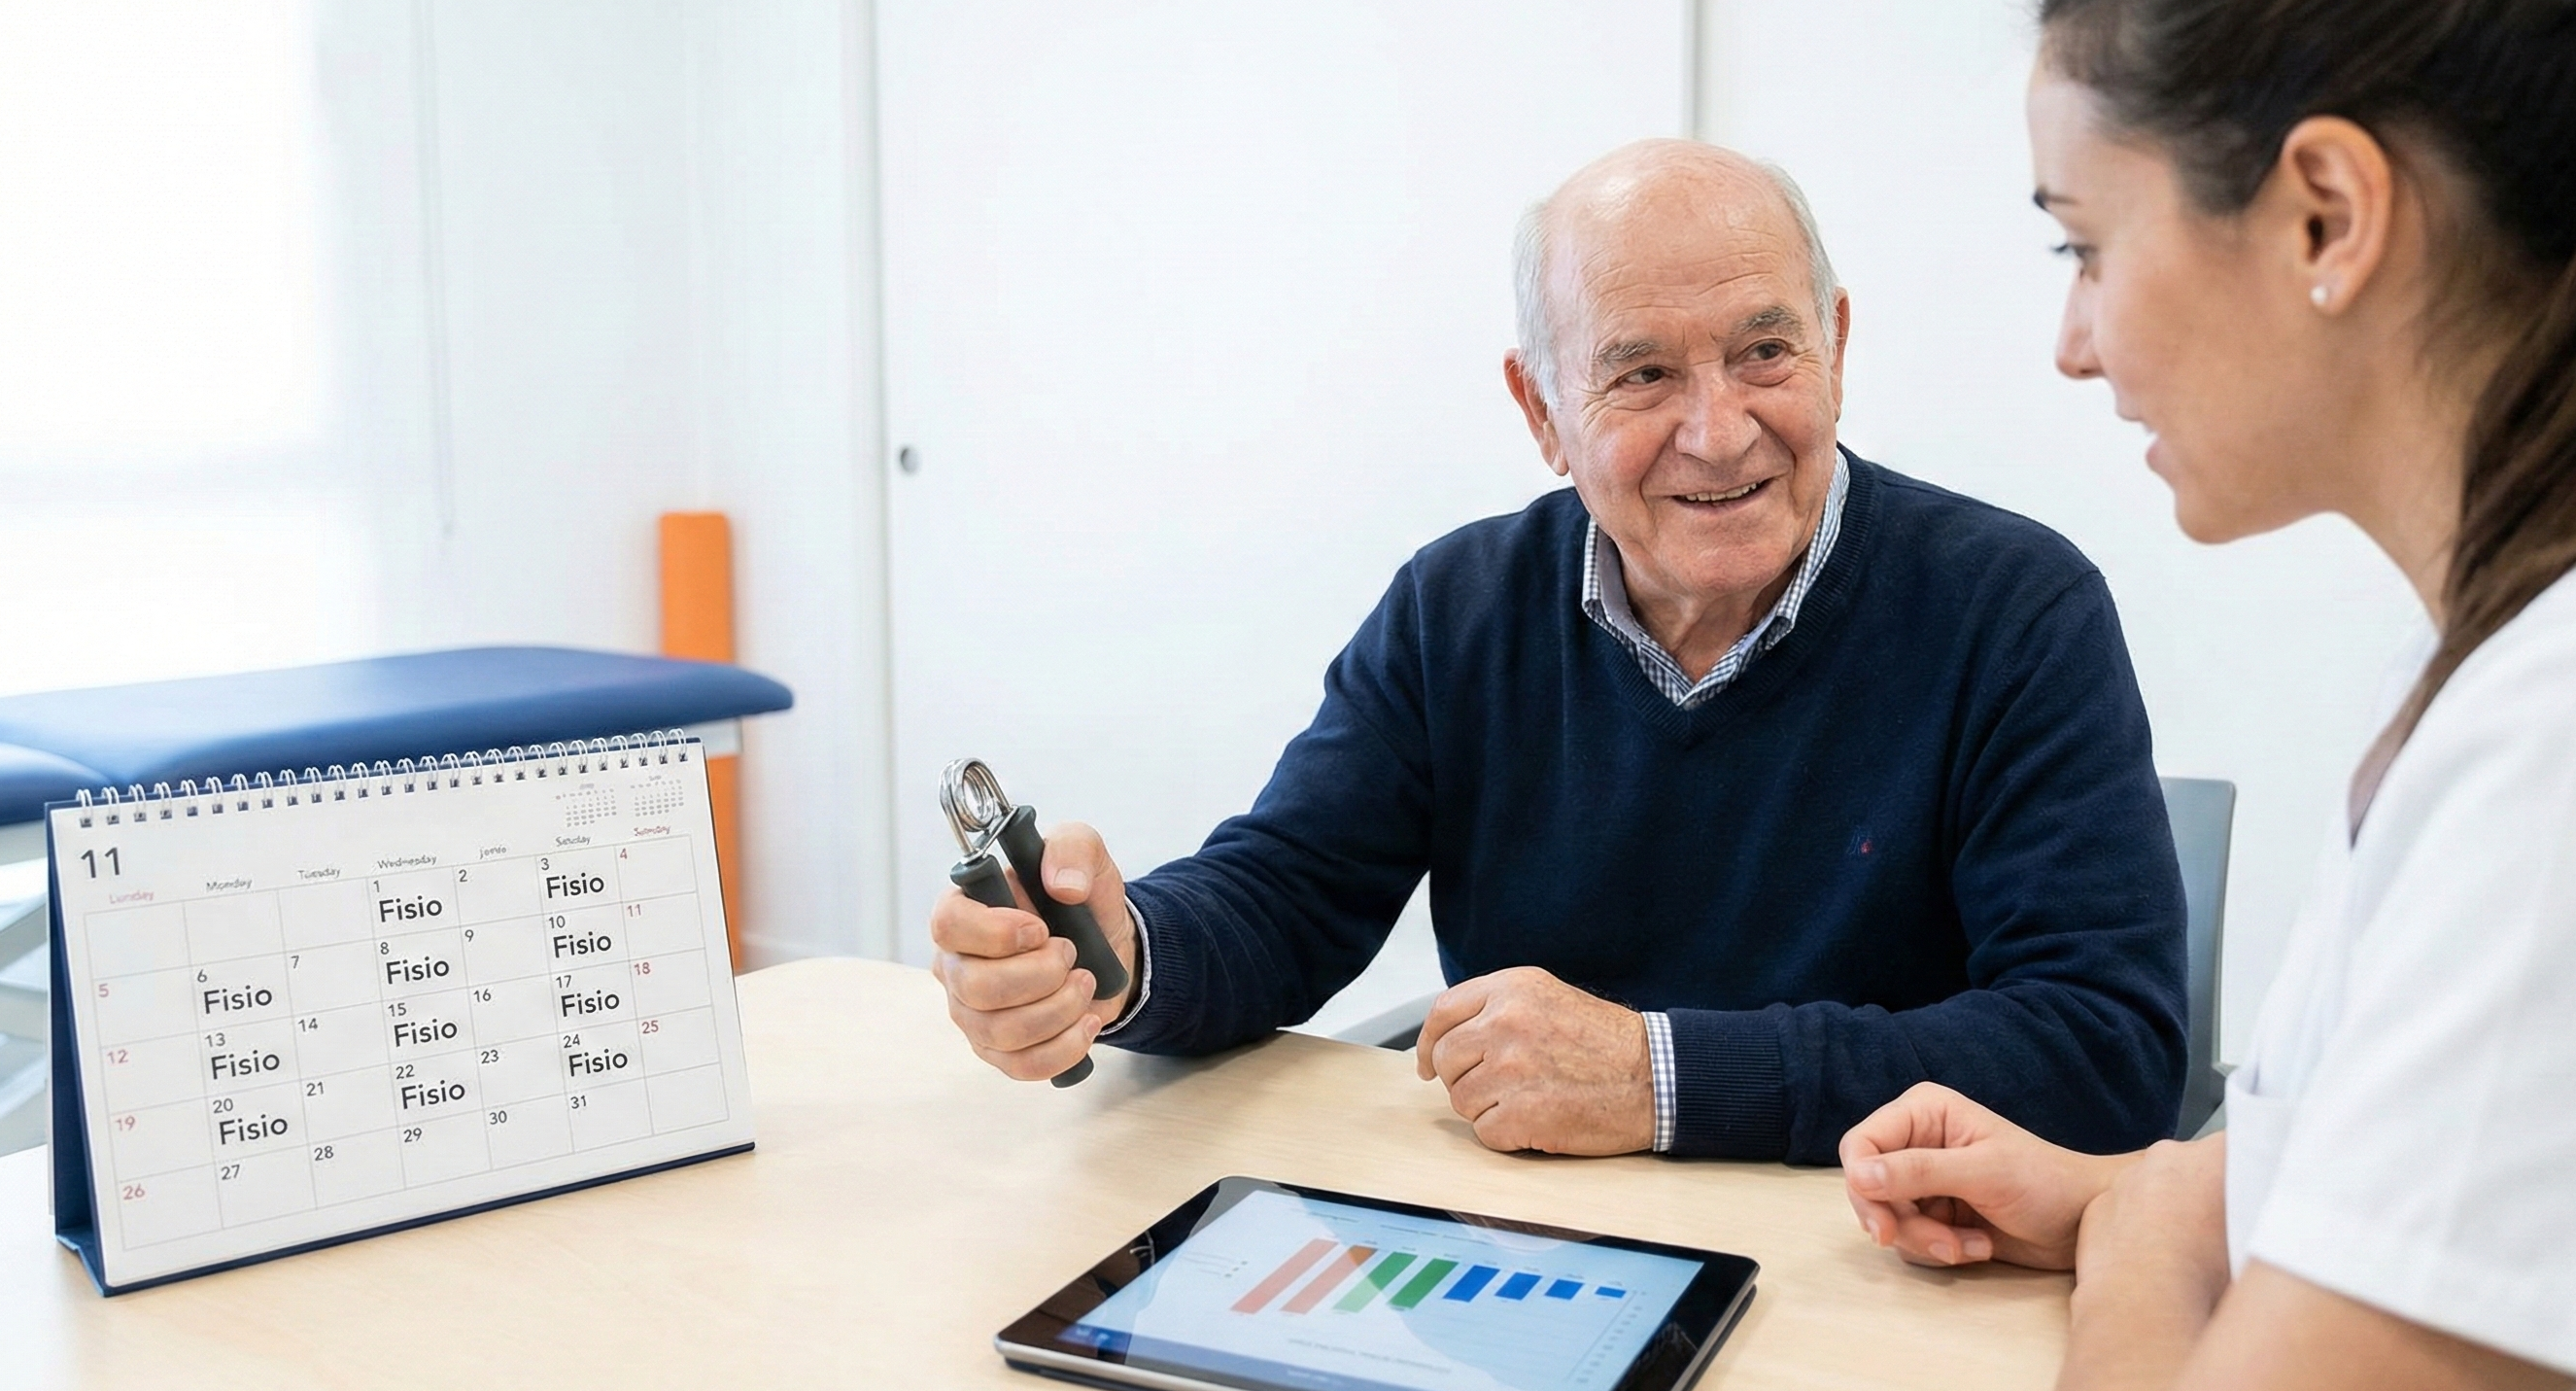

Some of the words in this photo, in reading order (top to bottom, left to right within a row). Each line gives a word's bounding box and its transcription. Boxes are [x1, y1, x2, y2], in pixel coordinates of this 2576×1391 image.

[619, 847, 628, 860] 4
[81, 848, 120, 878] 11
[540, 857, 550, 871] 3
[458, 868, 468, 883] 2
[372, 880, 380, 893] 1
[546, 873, 603, 898] Fisio
[379, 895, 442, 922] Fisio
[627, 903, 641, 918] 11
[548, 915, 567, 929] 10
[464, 928, 474, 943] 9
[380, 941, 390, 956] 8
[553, 931, 611, 957] Fisio
[291, 955, 300, 969] 7
[387, 956, 449, 984] Fisio
[634, 961, 651, 976] 18
[196, 968, 208, 984] 6
[555, 974, 572, 990] 17
[98, 982, 110, 998] 5
[473, 988, 492, 1003] 16
[204, 986, 272, 1014] Fisio
[561, 990, 619, 1017] Fisio
[388, 1002, 407, 1018] 15
[297, 1017, 319, 1032] 14
[641, 1019, 660, 1035] 25
[204, 1031, 226, 1048] 13
[395, 1019, 457, 1047] Fisio
[563, 1033, 581, 1049] 24
[107, 1048, 129, 1064] 12
[480, 1049, 499, 1064] 23
[568, 1049, 628, 1077] Fisio
[211, 1050, 280, 1080] Fisio
[395, 1063, 416, 1080] 22
[306, 1081, 325, 1097] 21
[401, 1080, 464, 1109] Fisio
[212, 1097, 234, 1115] 20
[569, 1095, 587, 1110] 31
[115, 1115, 136, 1131] 19
[489, 1109, 508, 1126] 30
[219, 1115, 288, 1145] Fisio
[403, 1127, 423, 1143] 29
[313, 1145, 334, 1162] 28
[221, 1164, 241, 1181] 27
[122, 1183, 146, 1201] 26
